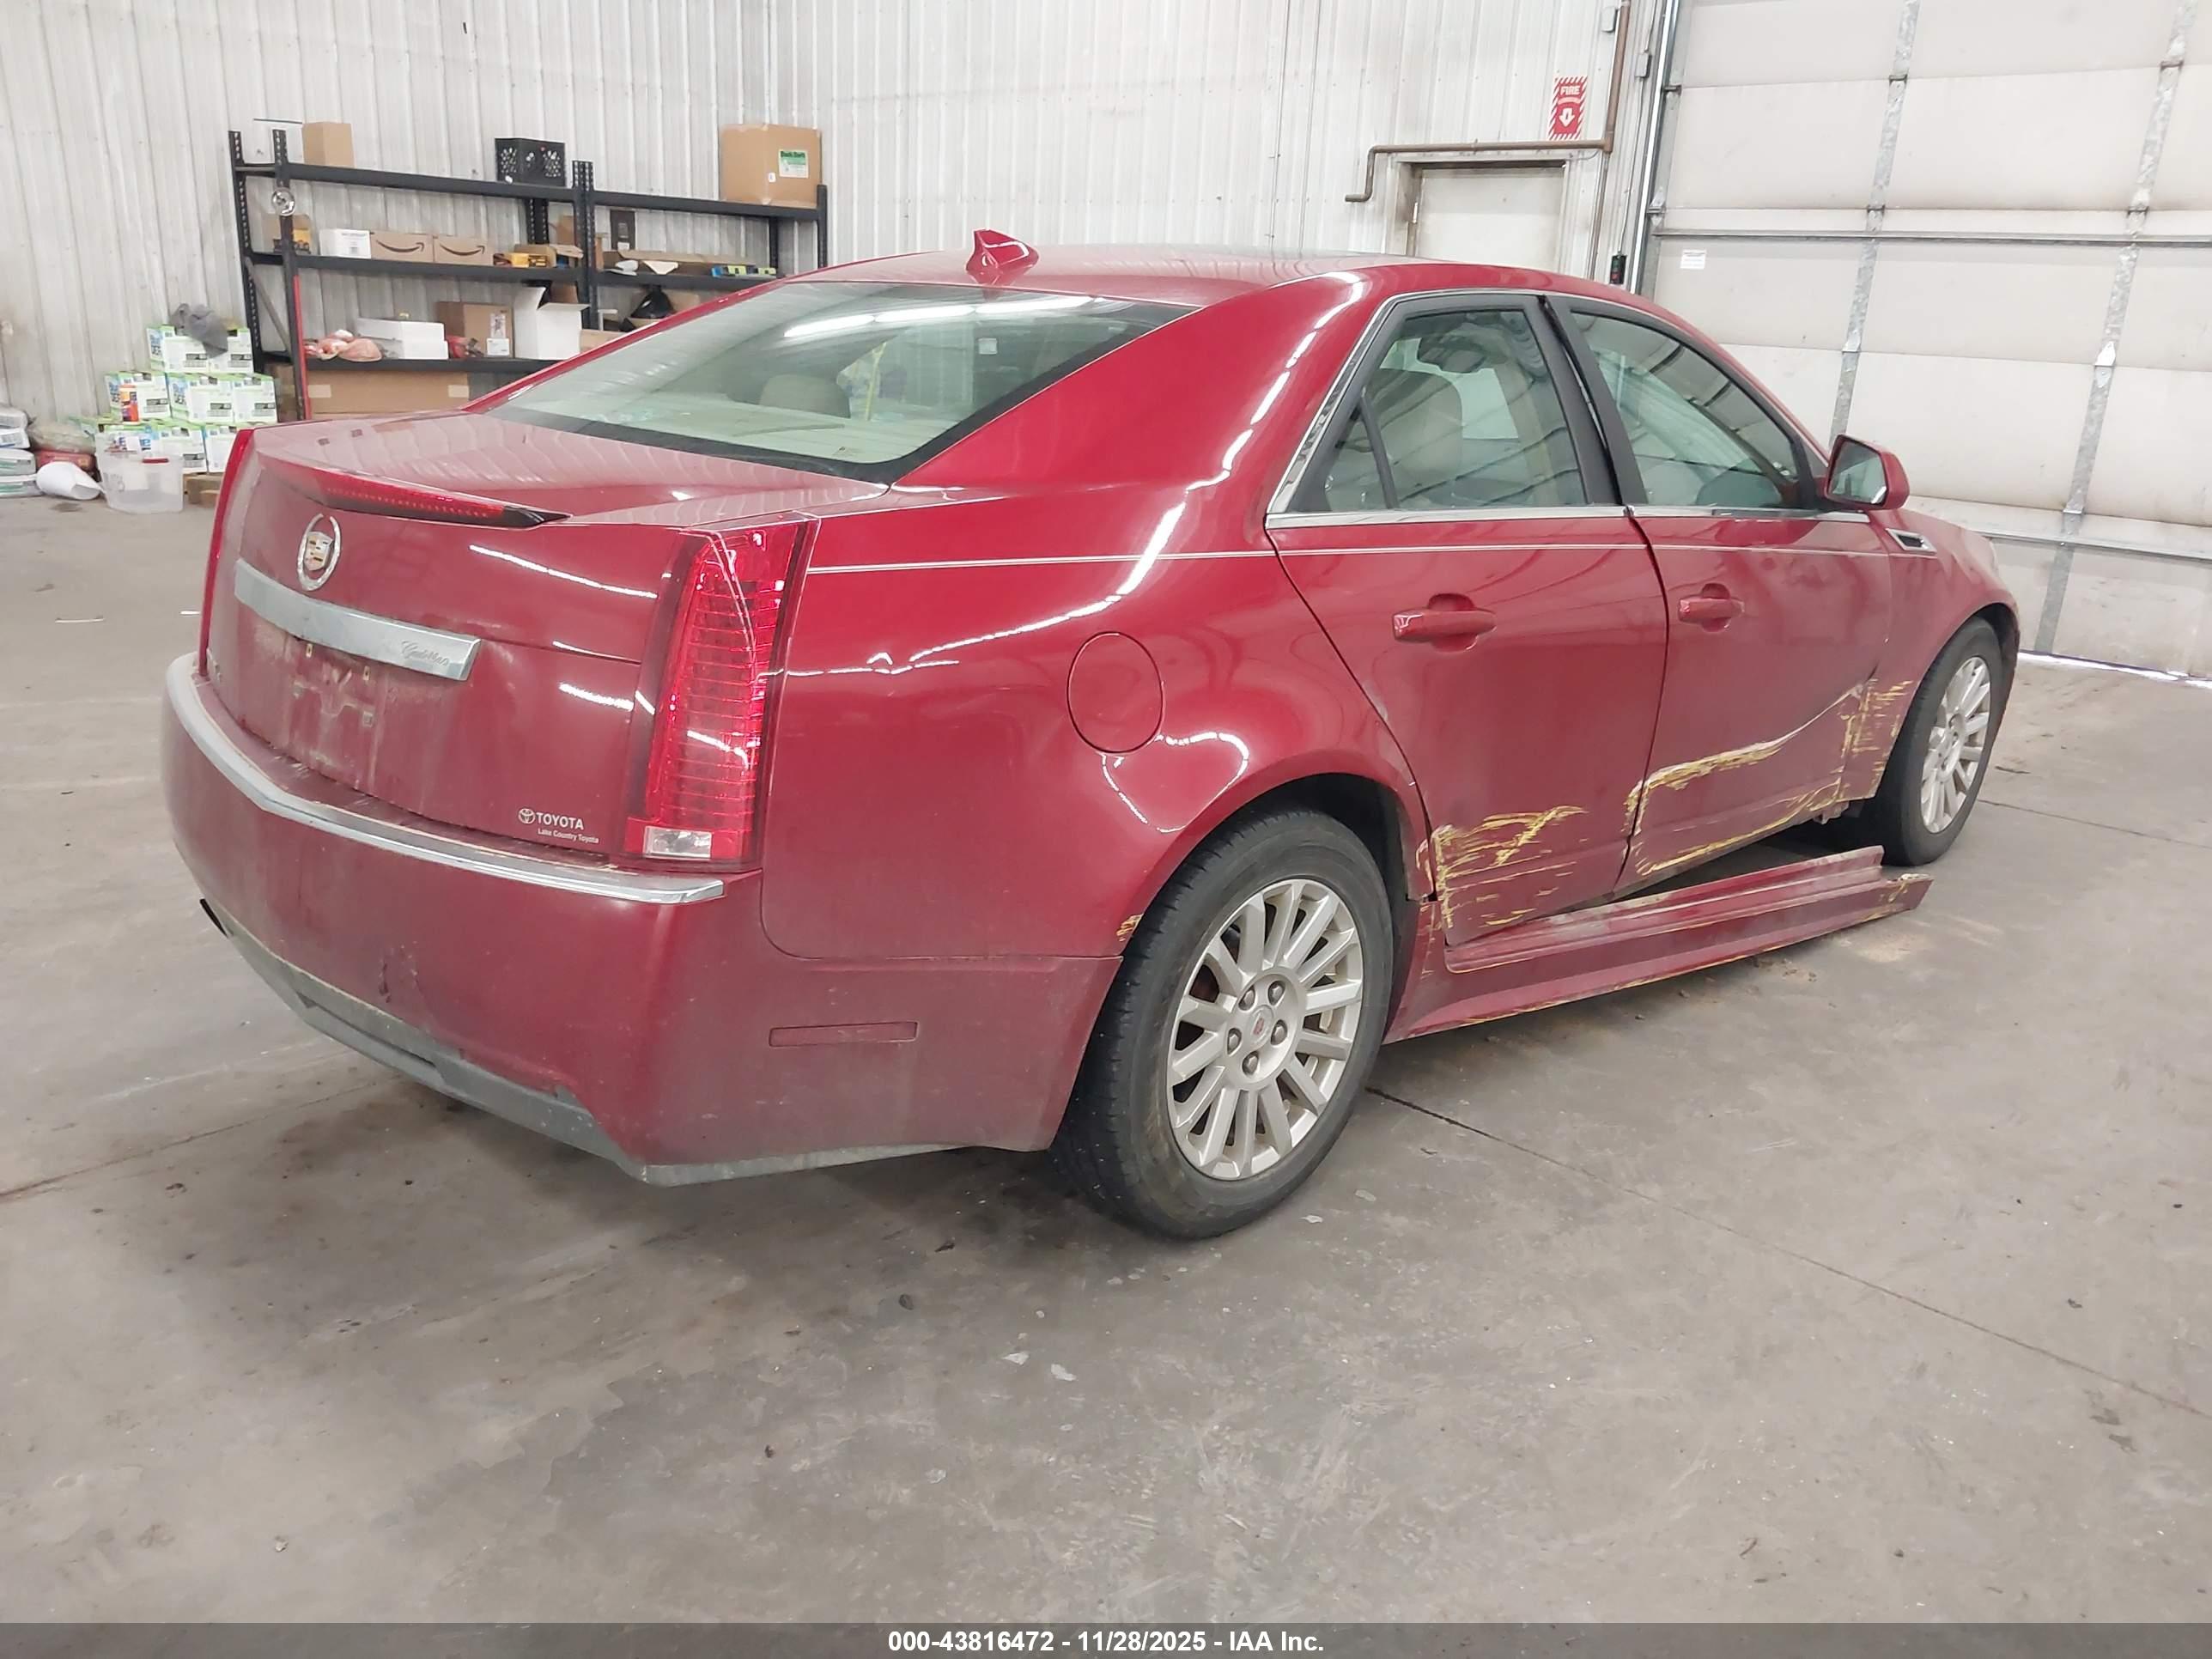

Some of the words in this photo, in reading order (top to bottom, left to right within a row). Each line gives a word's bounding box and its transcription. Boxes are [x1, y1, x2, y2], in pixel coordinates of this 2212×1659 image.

[1560, 85, 1581, 95] FIRE
[536, 811, 584, 830] TOYOTA
[538, 827, 552, 836] Lake
[553, 830, 577, 842] Country
[578, 834, 599, 844] Toyota
